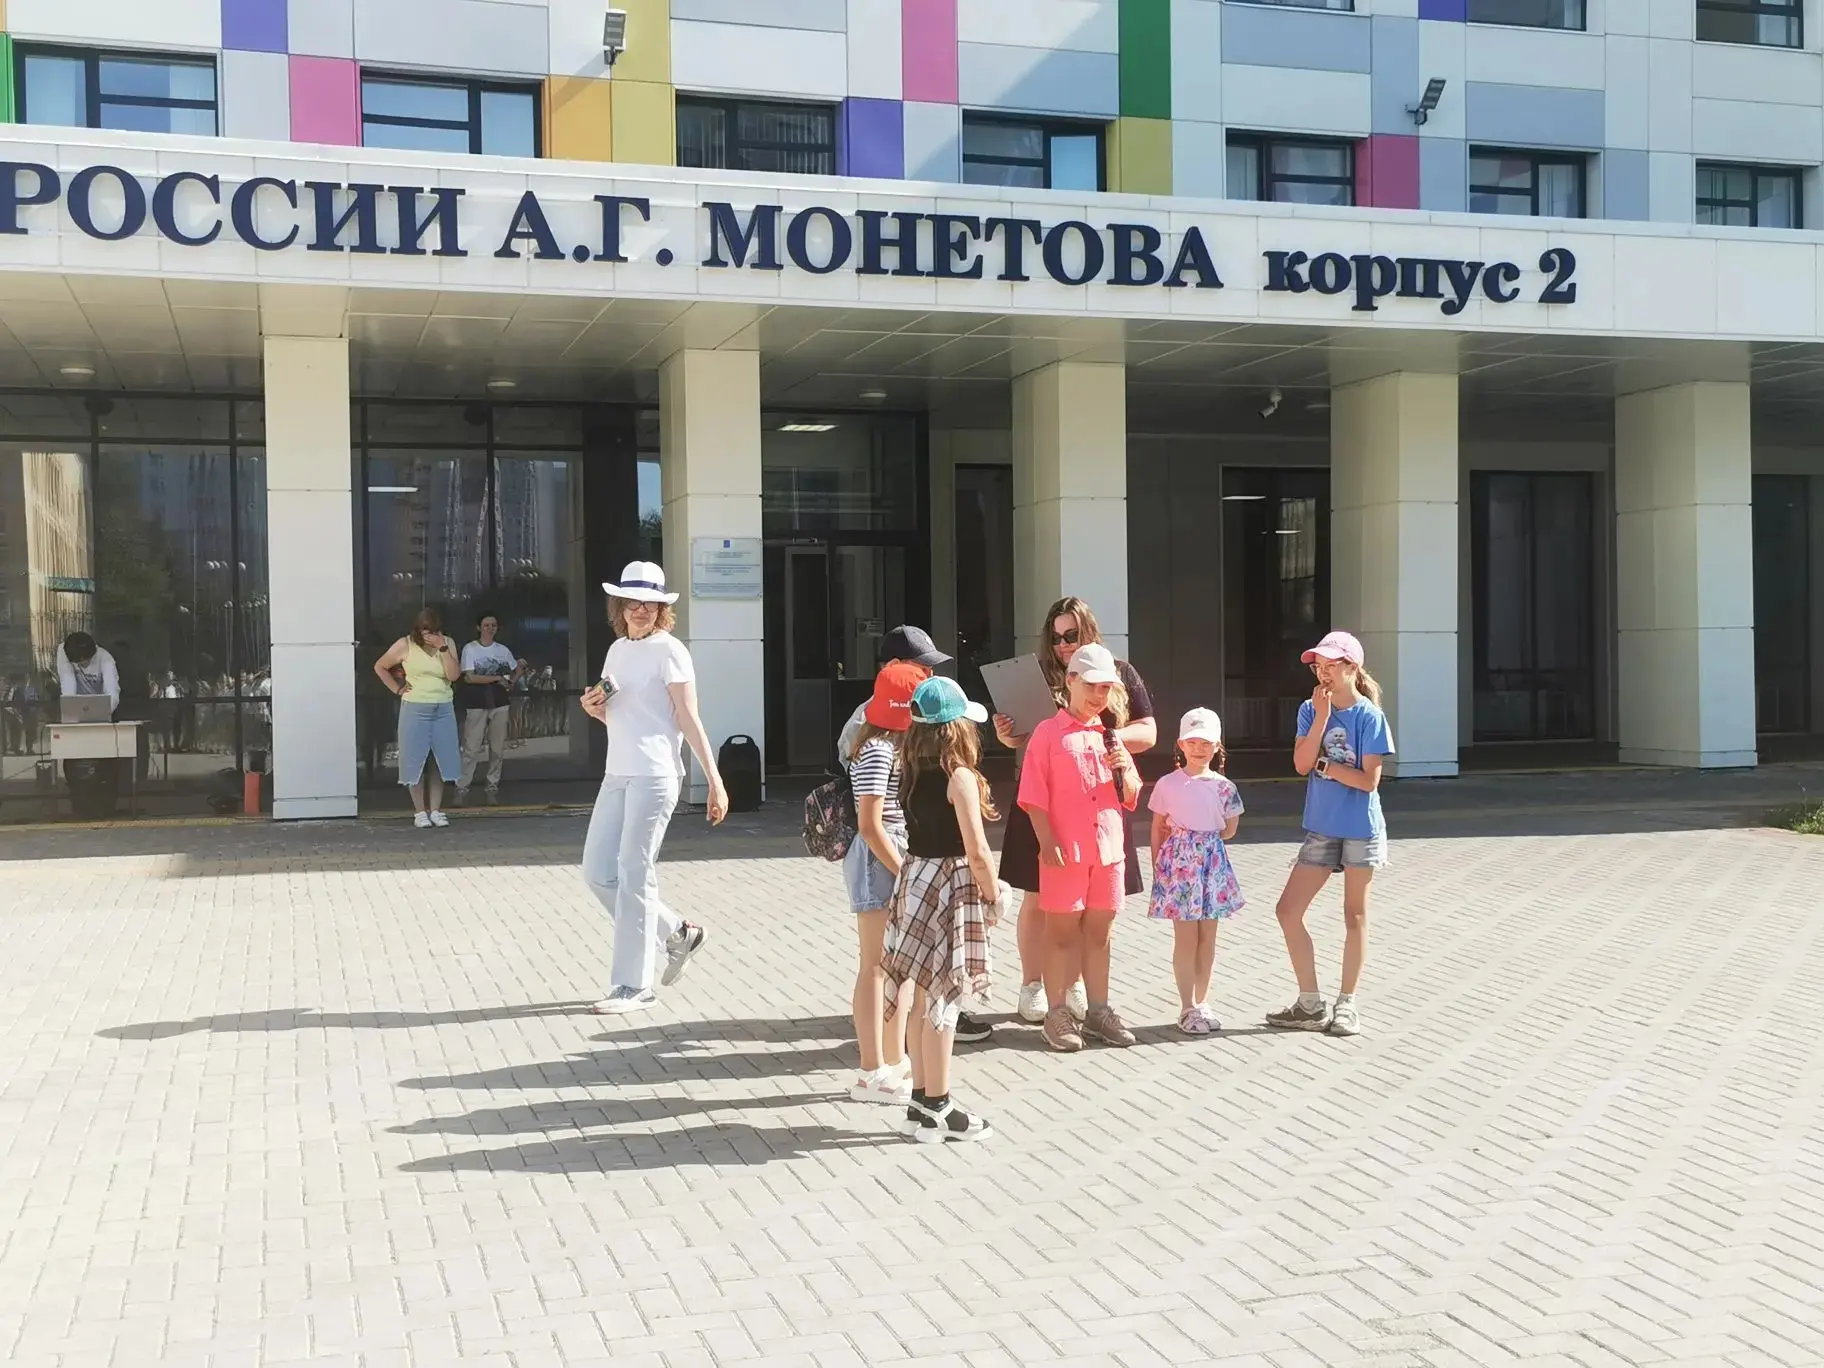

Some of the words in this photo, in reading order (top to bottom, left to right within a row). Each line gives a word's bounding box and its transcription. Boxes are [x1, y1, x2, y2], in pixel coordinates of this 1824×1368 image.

[0, 161, 468, 257] РОССИИ
[701, 201, 1225, 289] МОНЕТОВА
[1262, 248, 1521, 316] корпус
[1537, 247, 1577, 305] 2
